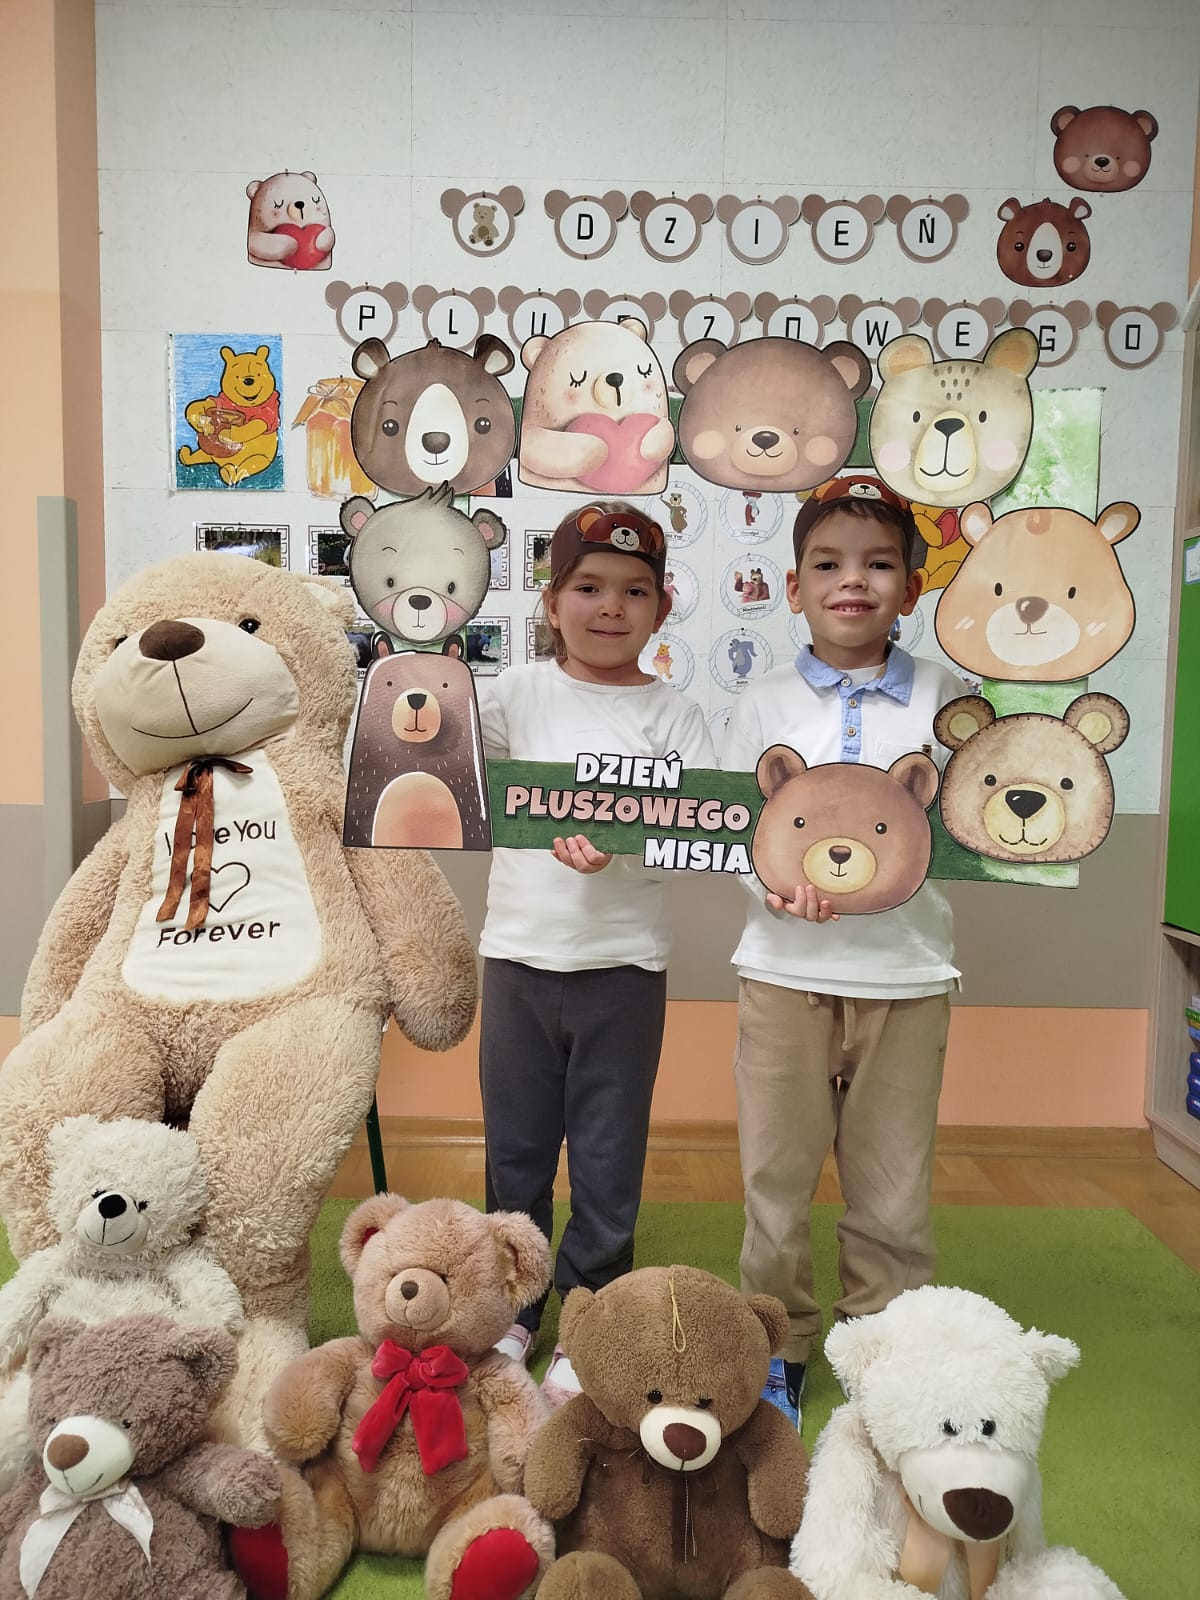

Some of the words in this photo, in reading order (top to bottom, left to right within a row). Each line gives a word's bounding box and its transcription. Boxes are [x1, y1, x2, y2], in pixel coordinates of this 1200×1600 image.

[577, 213, 936, 246] DZIEŃ
[358, 304, 1141, 351] PLUZOWEGO
[575, 750, 683, 789] DZIEŃ
[505, 785, 751, 831] PLUSZOWEGO
[233, 820, 276, 842] You
[644, 837, 752, 873] MISIA
[157, 921, 280, 948] Forever
